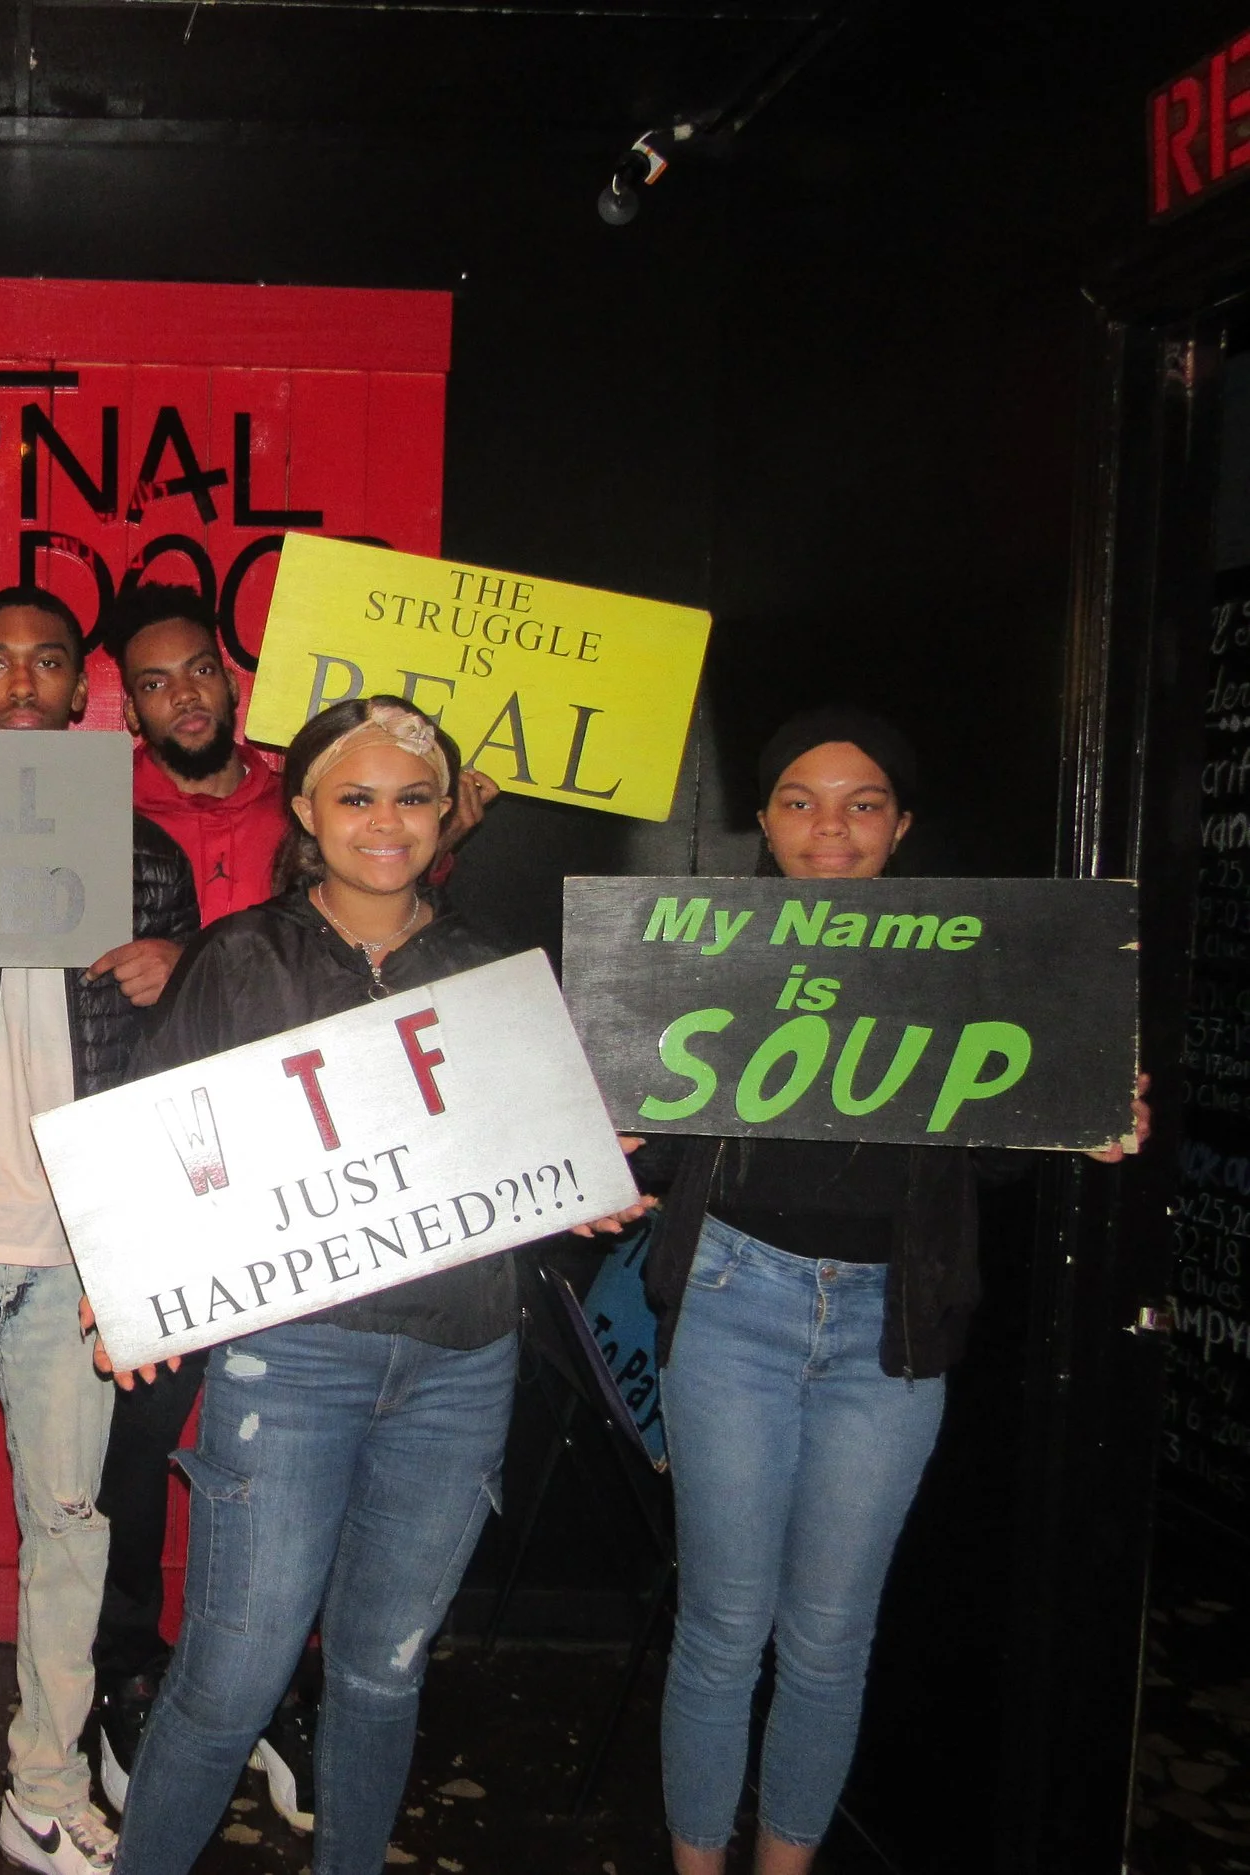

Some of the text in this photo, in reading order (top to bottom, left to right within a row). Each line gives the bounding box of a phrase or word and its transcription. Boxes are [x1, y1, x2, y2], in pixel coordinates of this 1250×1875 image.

[450, 570, 535, 613] THE
[364, 590, 603, 663] STRUGGLE
[456, 644, 494, 678] IS
[642, 897, 983, 956] My Name
[775, 965, 842, 1012] is
[637, 1007, 1033, 1134] SOUP
[269, 1144, 414, 1232] JUST
[147, 1157, 587, 1339] HAPPENED?!?!
